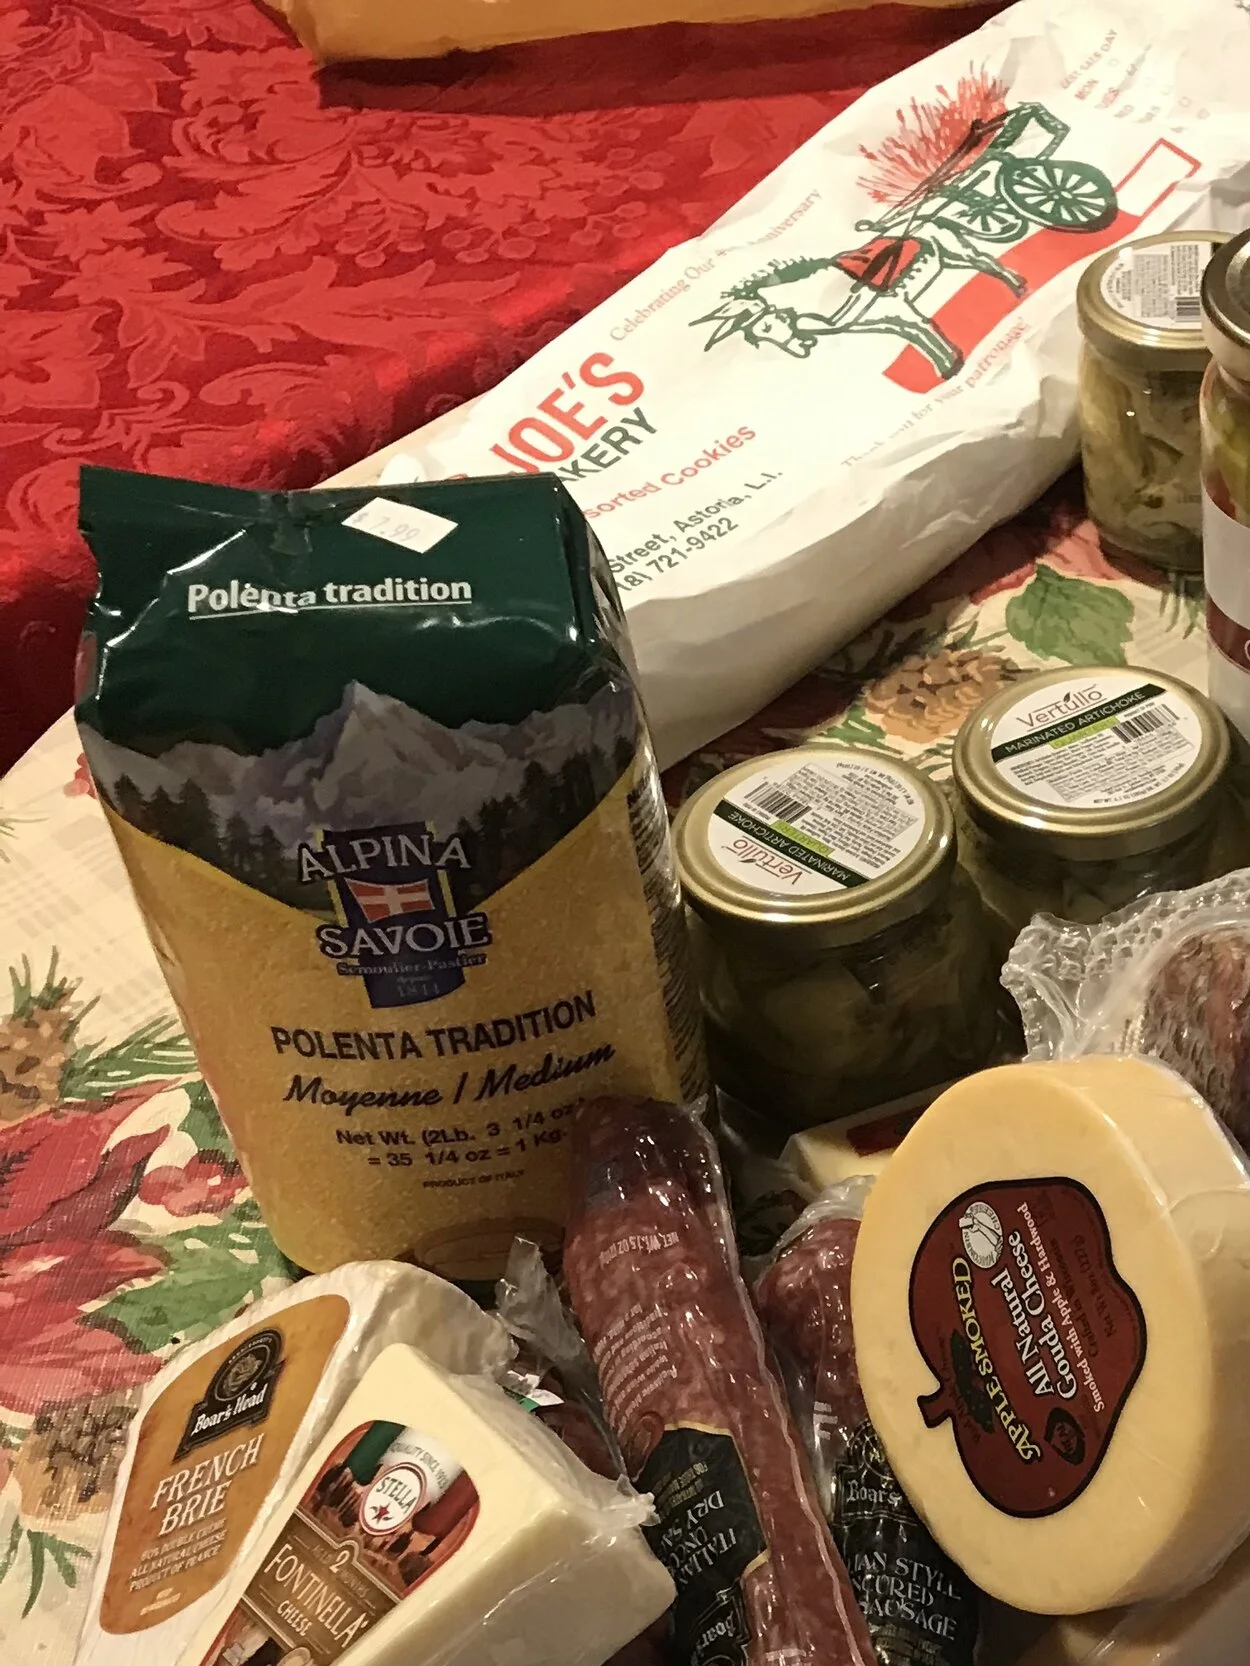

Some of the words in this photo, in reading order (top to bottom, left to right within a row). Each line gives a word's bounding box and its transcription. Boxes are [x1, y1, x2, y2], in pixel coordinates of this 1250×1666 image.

[610, 280, 691, 341] Celebrating
[684, 256, 715, 281] Our
[489, 352, 645, 474] JOE'S
[583, 481, 662, 519] sorted
[660, 425, 757, 486] Cookies
[672, 490, 753, 532] Astoria,
[645, 517, 739, 575] 721-9422
[324, 577, 472, 606] tradition
[1004, 721, 1077, 753] MARINATED
[1078, 691, 1146, 726] ARTICHOKE
[727, 811, 791, 849] ARTICHOKE
[301, 834, 471, 882] ALPINA
[788, 846, 852, 881] MARINATED
[319, 914, 489, 957] SAVOIE
[271, 1025, 423, 1061] POLENTA
[426, 990, 597, 1054] TRADITION
[282, 1074, 444, 1116] Moyenne
[474, 1041, 617, 1102] Medium
[336, 1128, 375, 1146] Net
[487, 1121, 500, 1138] 3
[512, 1110, 546, 1131] 1/4
[387, 1152, 413, 1167] 35
[424, 1149, 459, 1166] 1/4
[465, 1149, 493, 1163] oz
[515, 1139, 527, 1154] 1
[1016, 1202, 1051, 1273] Hardwood
[1008, 1231, 1046, 1317] Cheese
[1045, 1275, 1057, 1288] &
[951, 1257, 994, 1376] SMOKED
[990, 1267, 1045, 1356] Natural
[1052, 1290, 1076, 1329] Apple
[1038, 1319, 1078, 1400] Gouda
[1065, 1328, 1087, 1360] with
[1024, 1358, 1055, 1397] All
[1074, 1359, 1106, 1413] Smoked
[191, 1402, 233, 1436] Boar's
[232, 1382, 270, 1418] Head
[985, 1374, 1042, 1461] APPLE
[150, 1432, 265, 1511] FRENCH
[375, 1475, 418, 1515] STELLA
[158, 1480, 232, 1536] BRIE
[686, 1489, 724, 1529] DRY
[329, 1549, 351, 1574] 2
[264, 1543, 366, 1648] FONTINELLA
[276, 1599, 313, 1637] CHEESE
